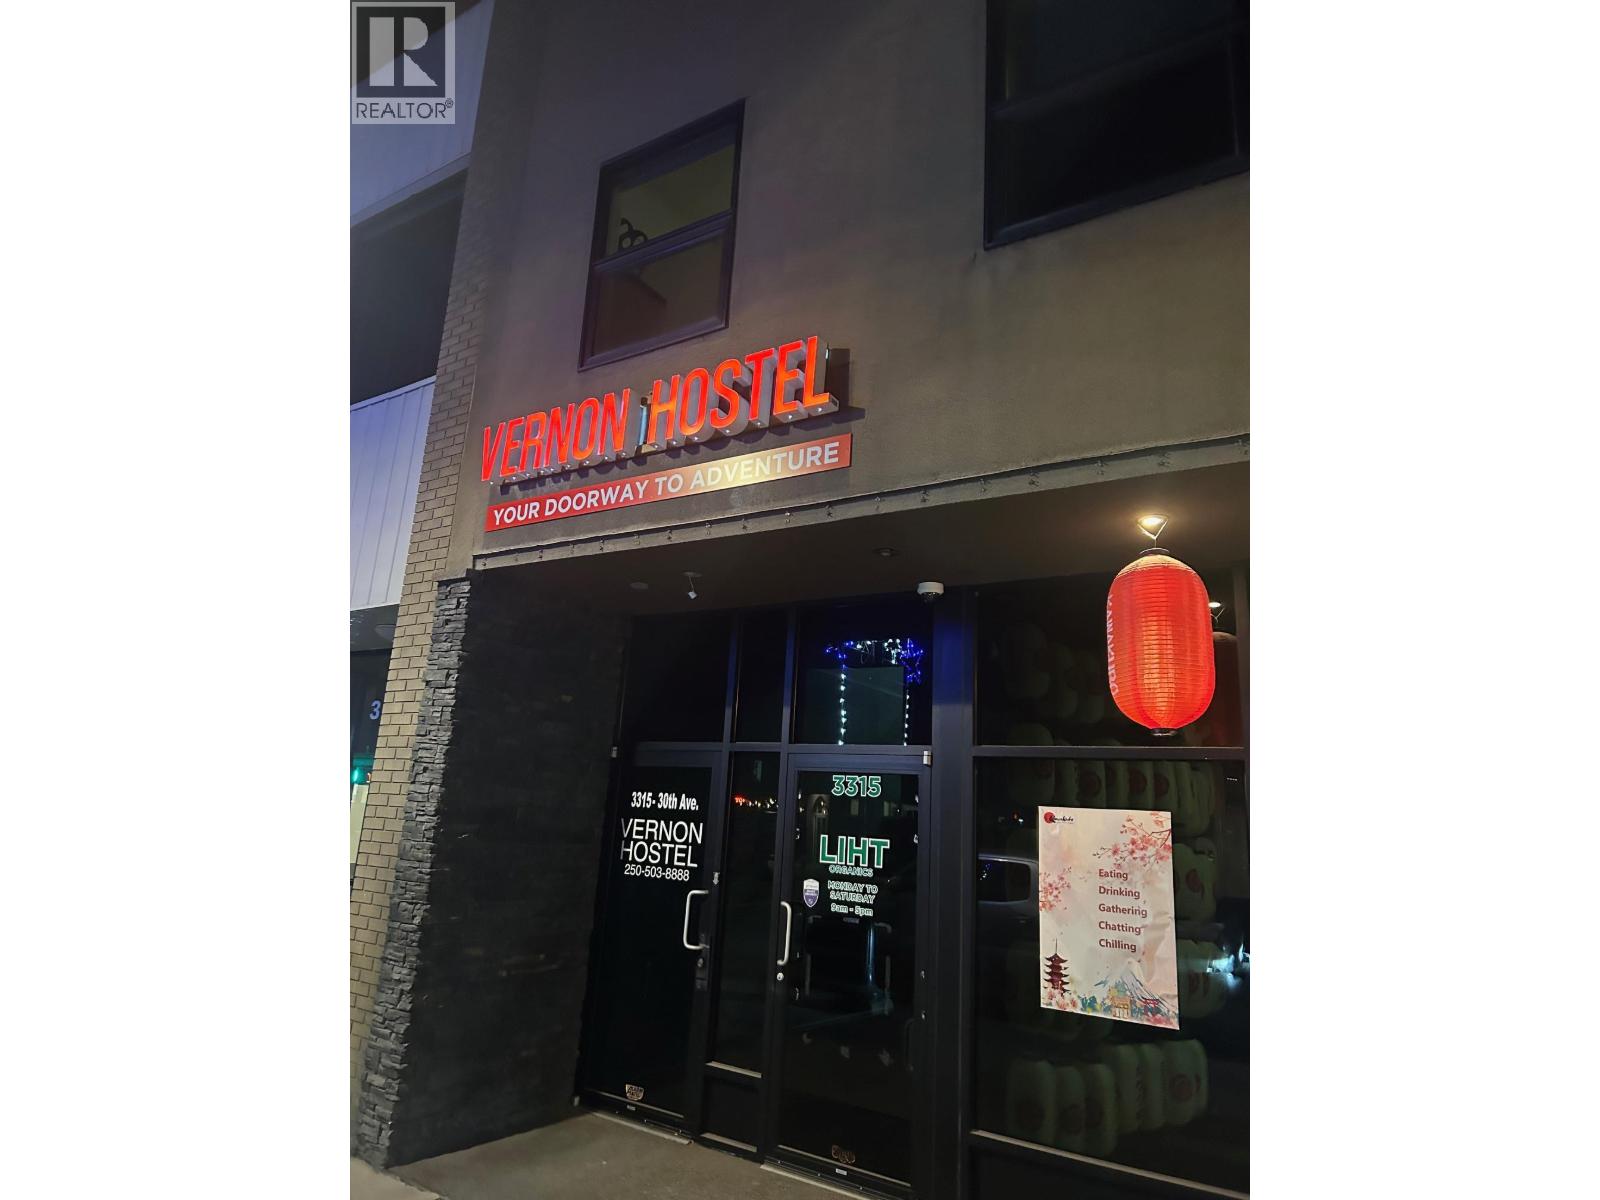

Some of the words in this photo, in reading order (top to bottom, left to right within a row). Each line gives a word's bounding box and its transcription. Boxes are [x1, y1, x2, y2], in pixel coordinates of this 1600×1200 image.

[481, 388, 631, 481] VERNON
[647, 336, 830, 444] HOSTEL
[494, 498, 539, 525] YOUR
[545, 480, 648, 513] DOORWAY
[655, 471, 684, 495] TO
[691, 442, 840, 489] ADVENTURE
[831, 775, 882, 798] 3315
[658, 792, 678, 810] 30th
[679, 793, 699, 811] Ave.
[621, 818, 704, 844] VERNON
[620, 840, 698, 868] HOSTEL
[819, 834, 890, 869] LIHT
[624, 863, 690, 882] 250-503-8888
[828, 864, 874, 878] ORGANICS
[1098, 868, 1129, 881] Eating
[828, 880, 865, 893] MONDAY
[866, 884, 879, 894] TO
[1098, 886, 1141, 899] Drinking
[829, 890, 876, 905] SATURDAY
[830, 902, 849, 913] 9am
[854, 905, 873, 917] 5pm
[1098, 903, 1148, 918] Gathering
[1098, 921, 1142, 936] Chatting
[1098, 938, 1137, 953] Chilling
